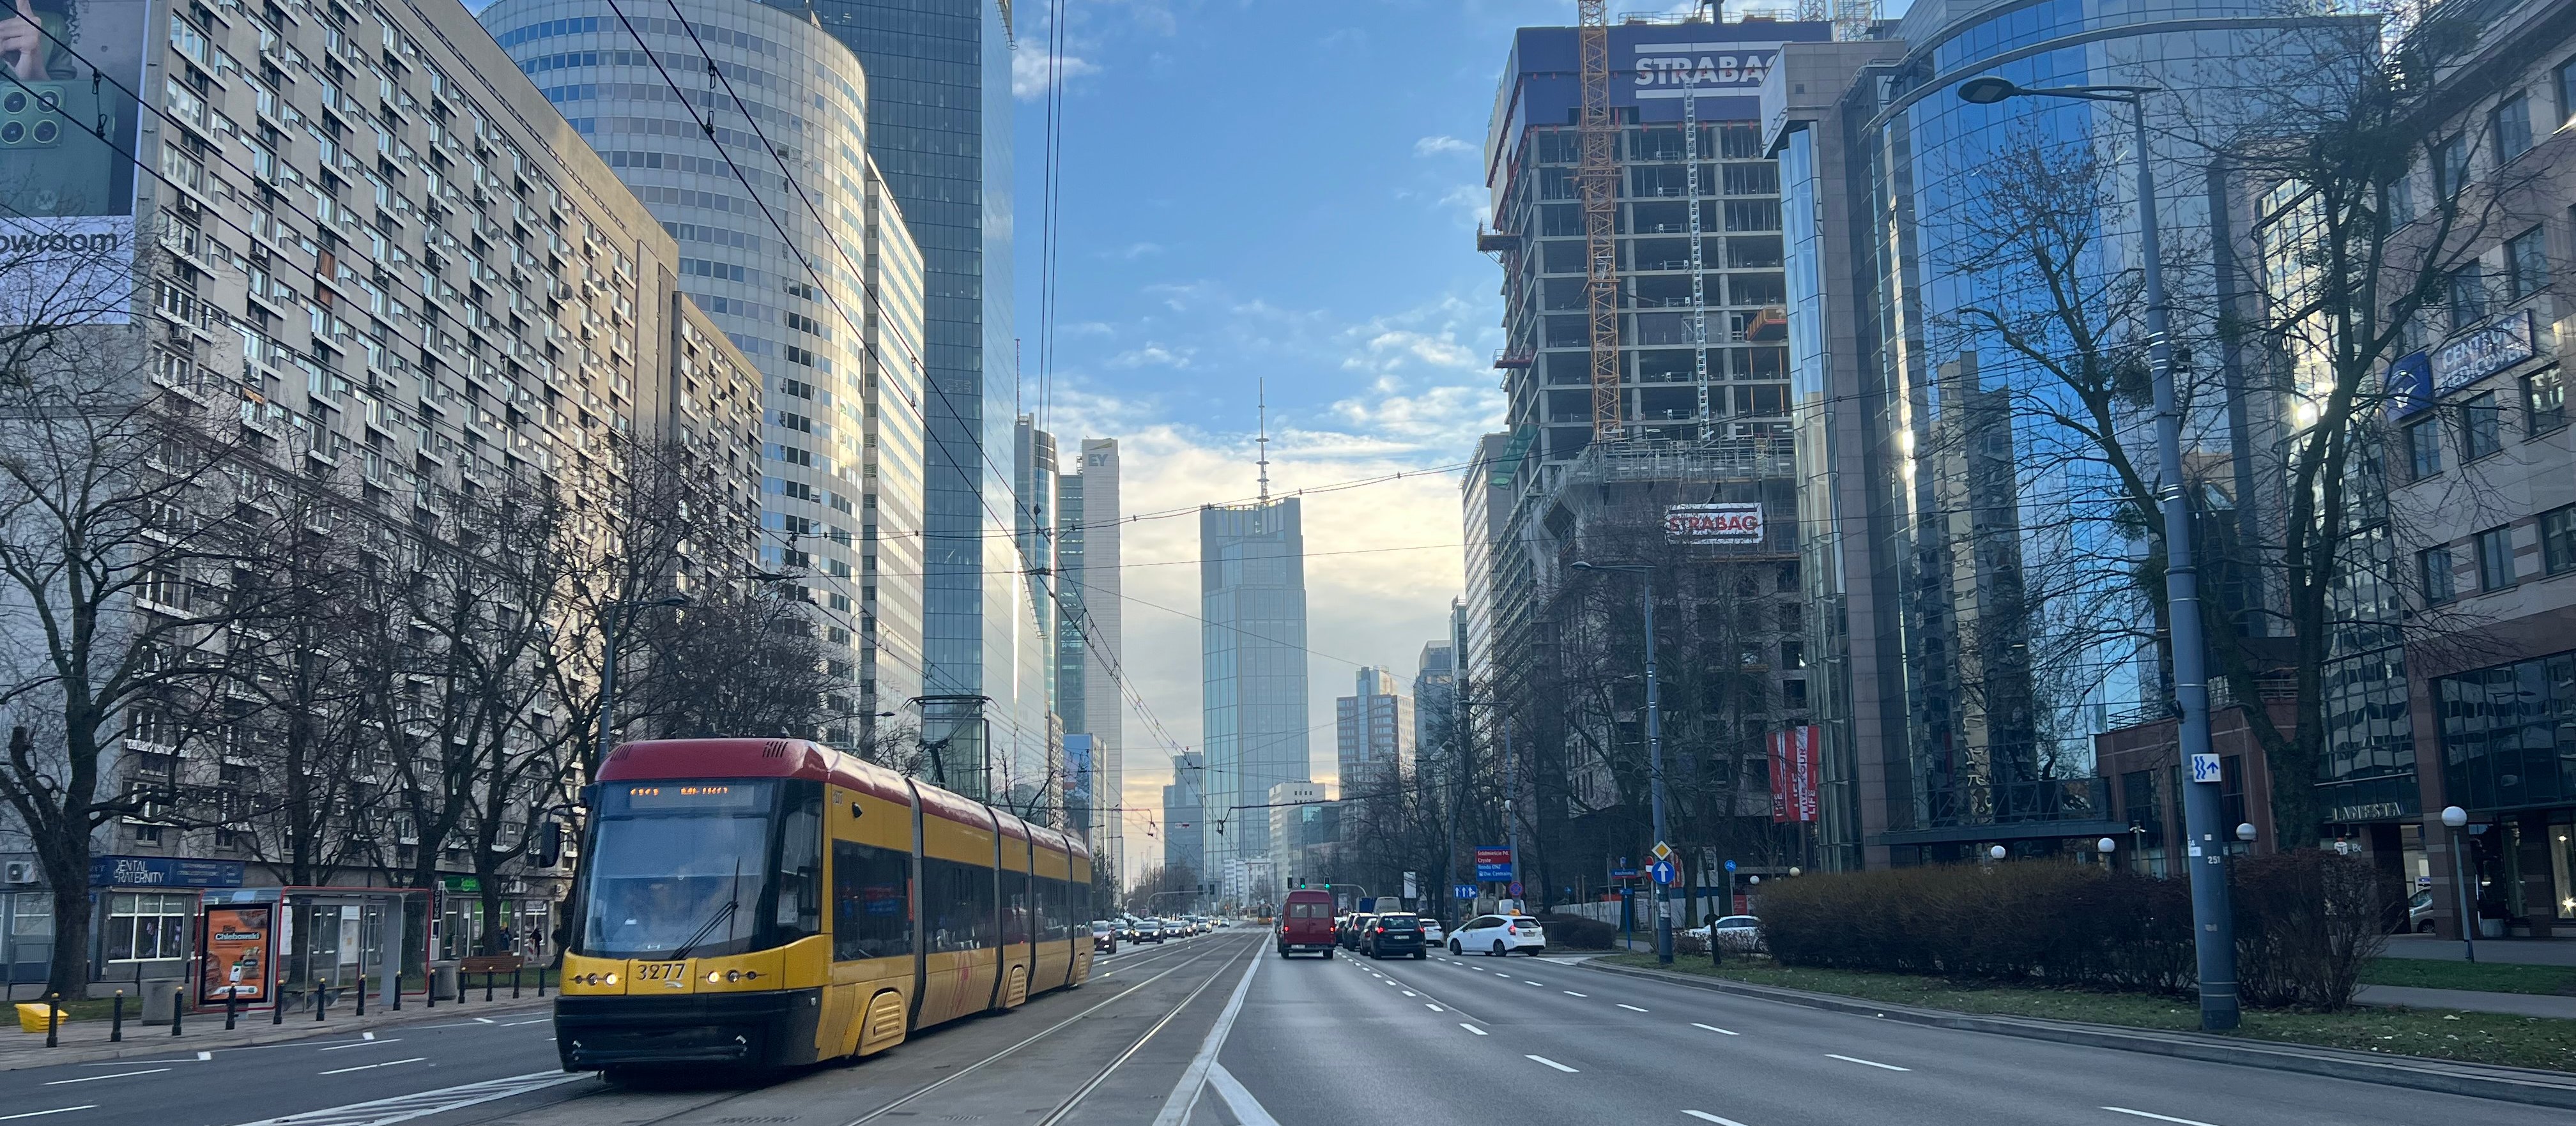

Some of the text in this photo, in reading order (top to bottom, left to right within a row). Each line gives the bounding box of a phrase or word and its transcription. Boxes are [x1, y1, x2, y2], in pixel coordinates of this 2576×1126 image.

[1088, 454, 1108, 466] EY
[2207, 856, 2220, 864] 251
[114, 871, 164, 883] FRATERNITY
[636, 963, 686, 980] 3277
